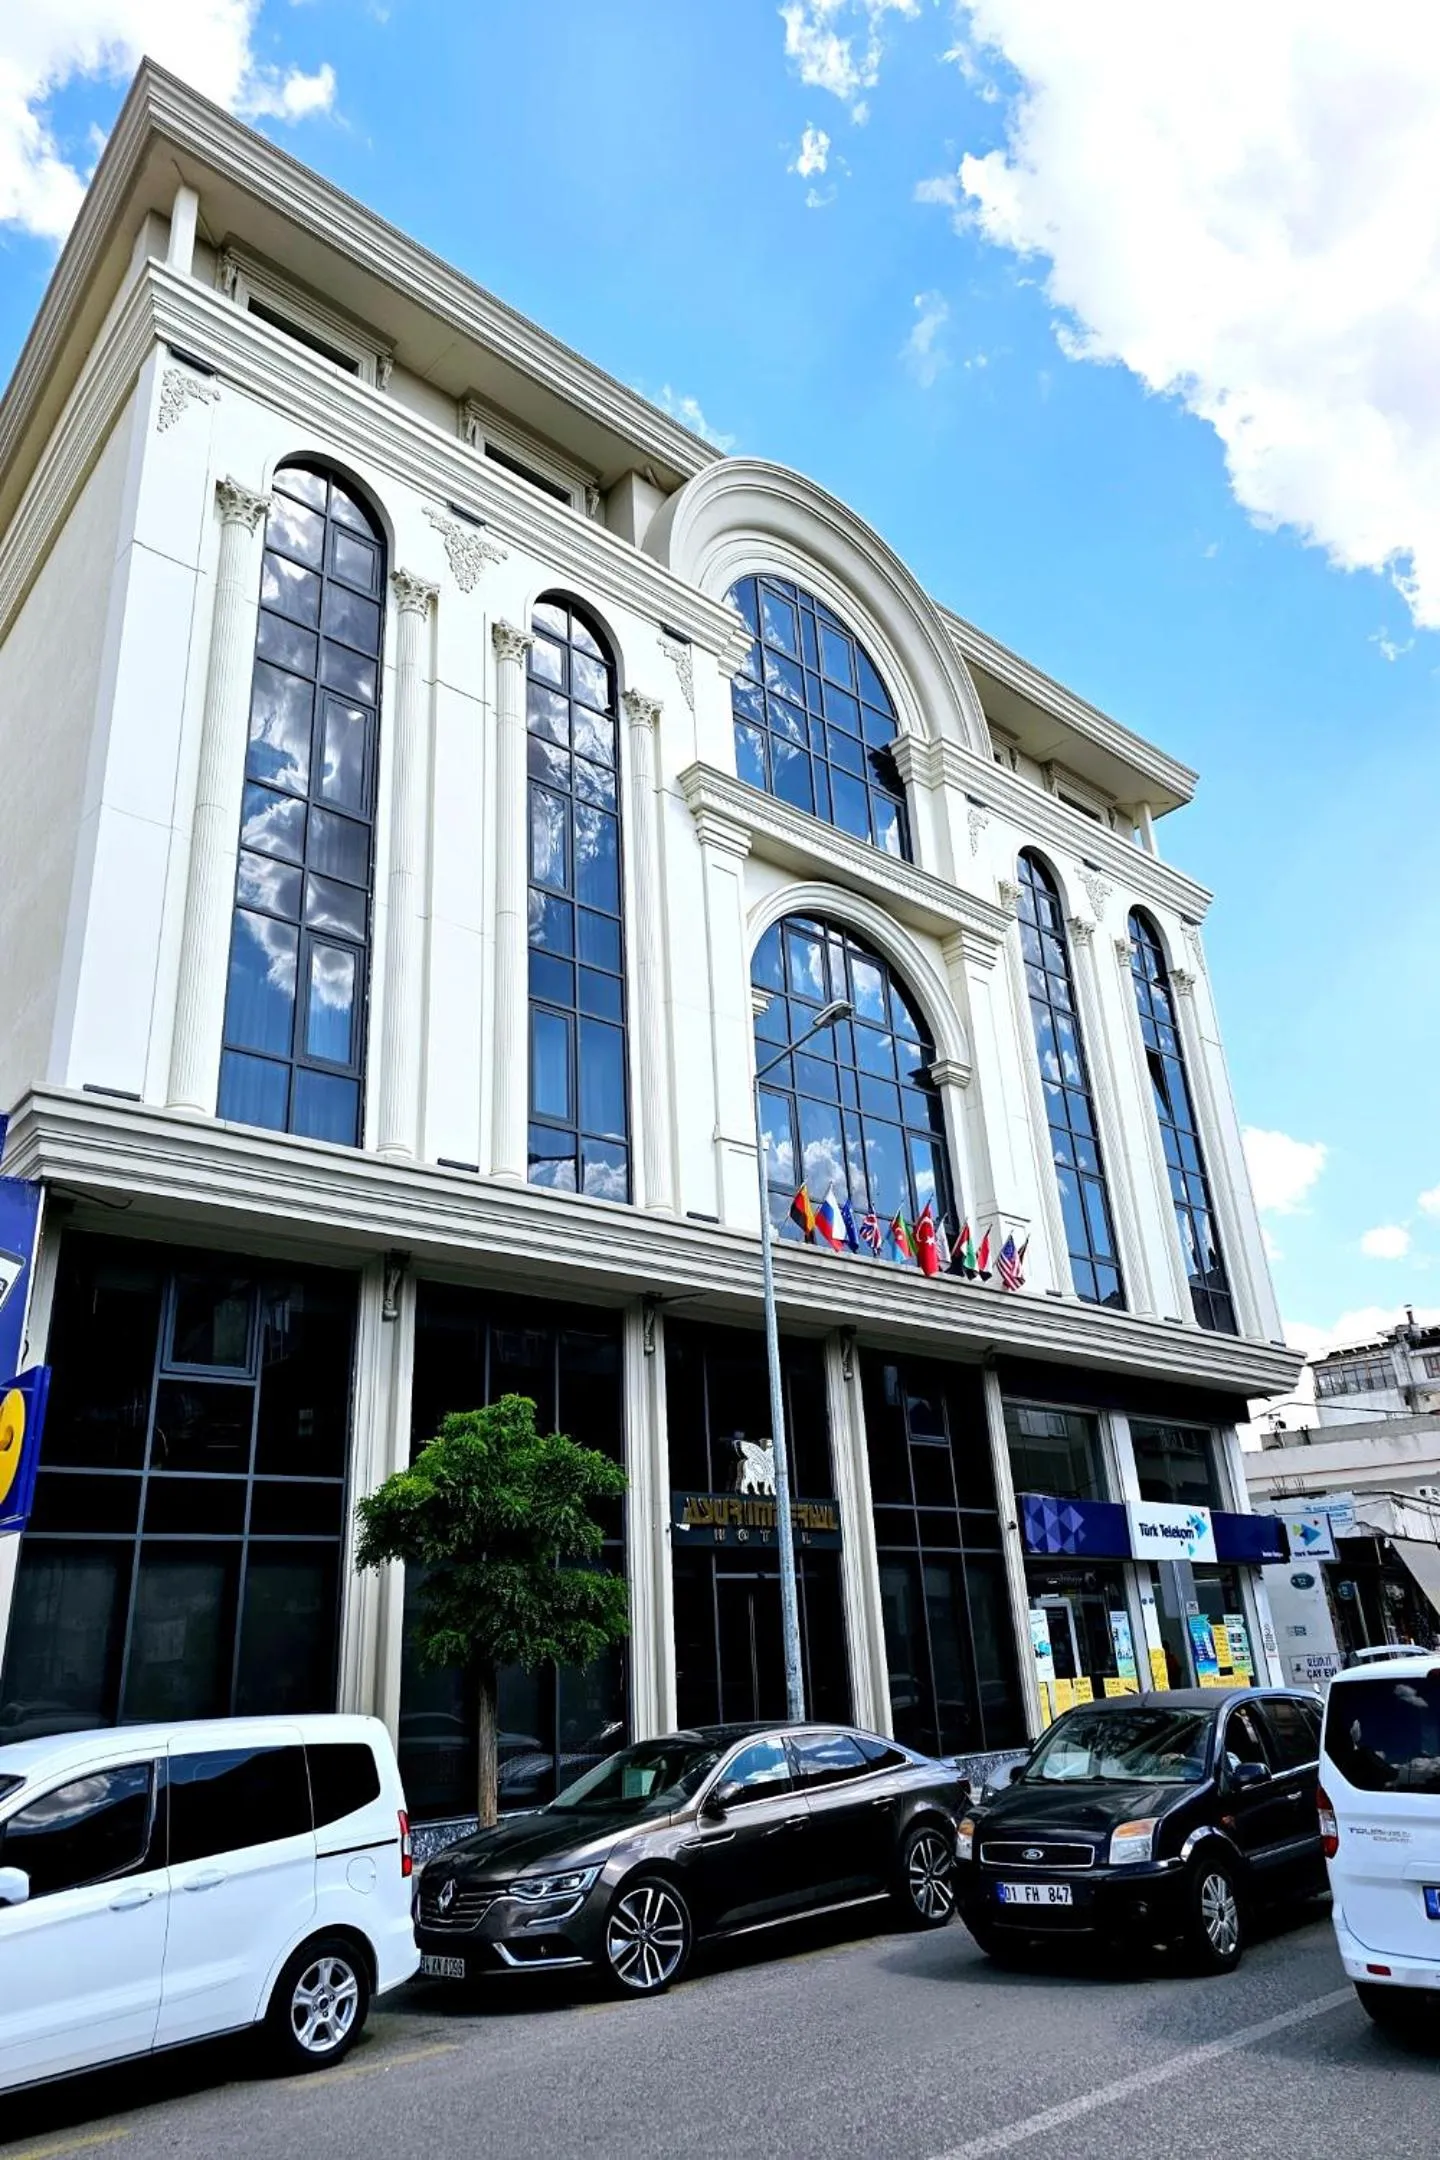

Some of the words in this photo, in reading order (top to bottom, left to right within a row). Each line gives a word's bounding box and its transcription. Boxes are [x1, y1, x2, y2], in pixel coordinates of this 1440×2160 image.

[713, 1527, 812, 1545] HOTL
[1139, 1523, 1158, 1537] Türk
[1159, 1524, 1194, 1539] Telekom
[1025, 1886, 1040, 1901] FH
[1048, 1886, 1070, 1903] 847
